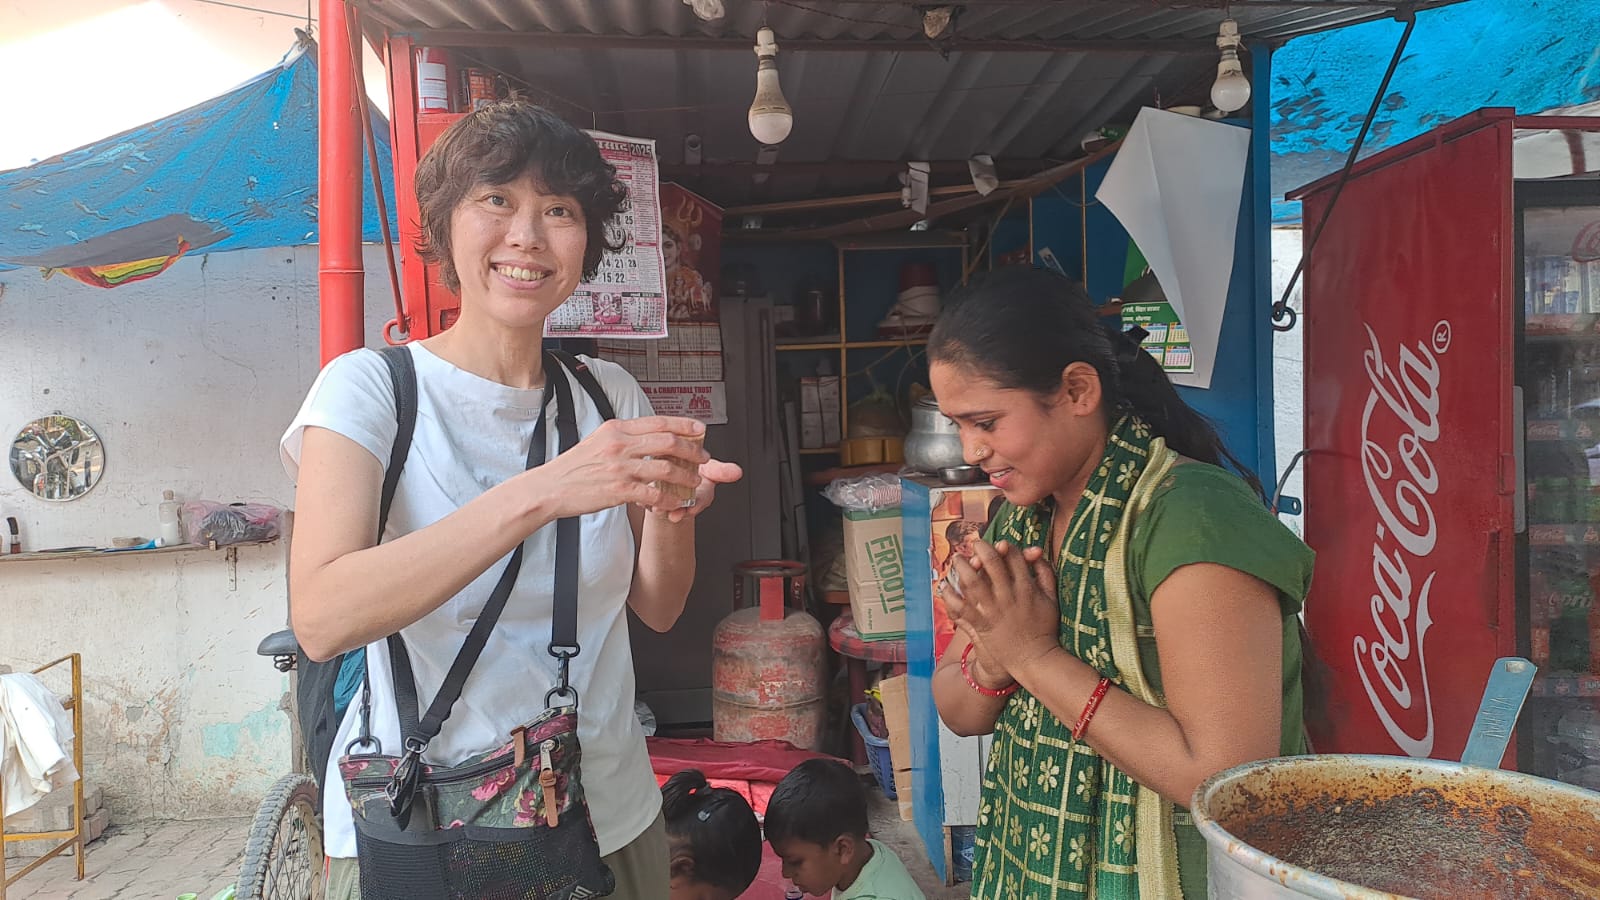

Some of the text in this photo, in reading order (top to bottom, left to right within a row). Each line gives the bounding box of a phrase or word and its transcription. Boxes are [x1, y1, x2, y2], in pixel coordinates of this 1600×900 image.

[630, 143, 652, 157] 2025
[624, 215, 633, 225] 25
[625, 246, 634, 255] 27
[614, 259, 624, 269] 21
[602, 272, 625, 283] 15 22
[694, 386, 712, 394] TRUST
[1353, 322, 1440, 758] Coca-Cola
